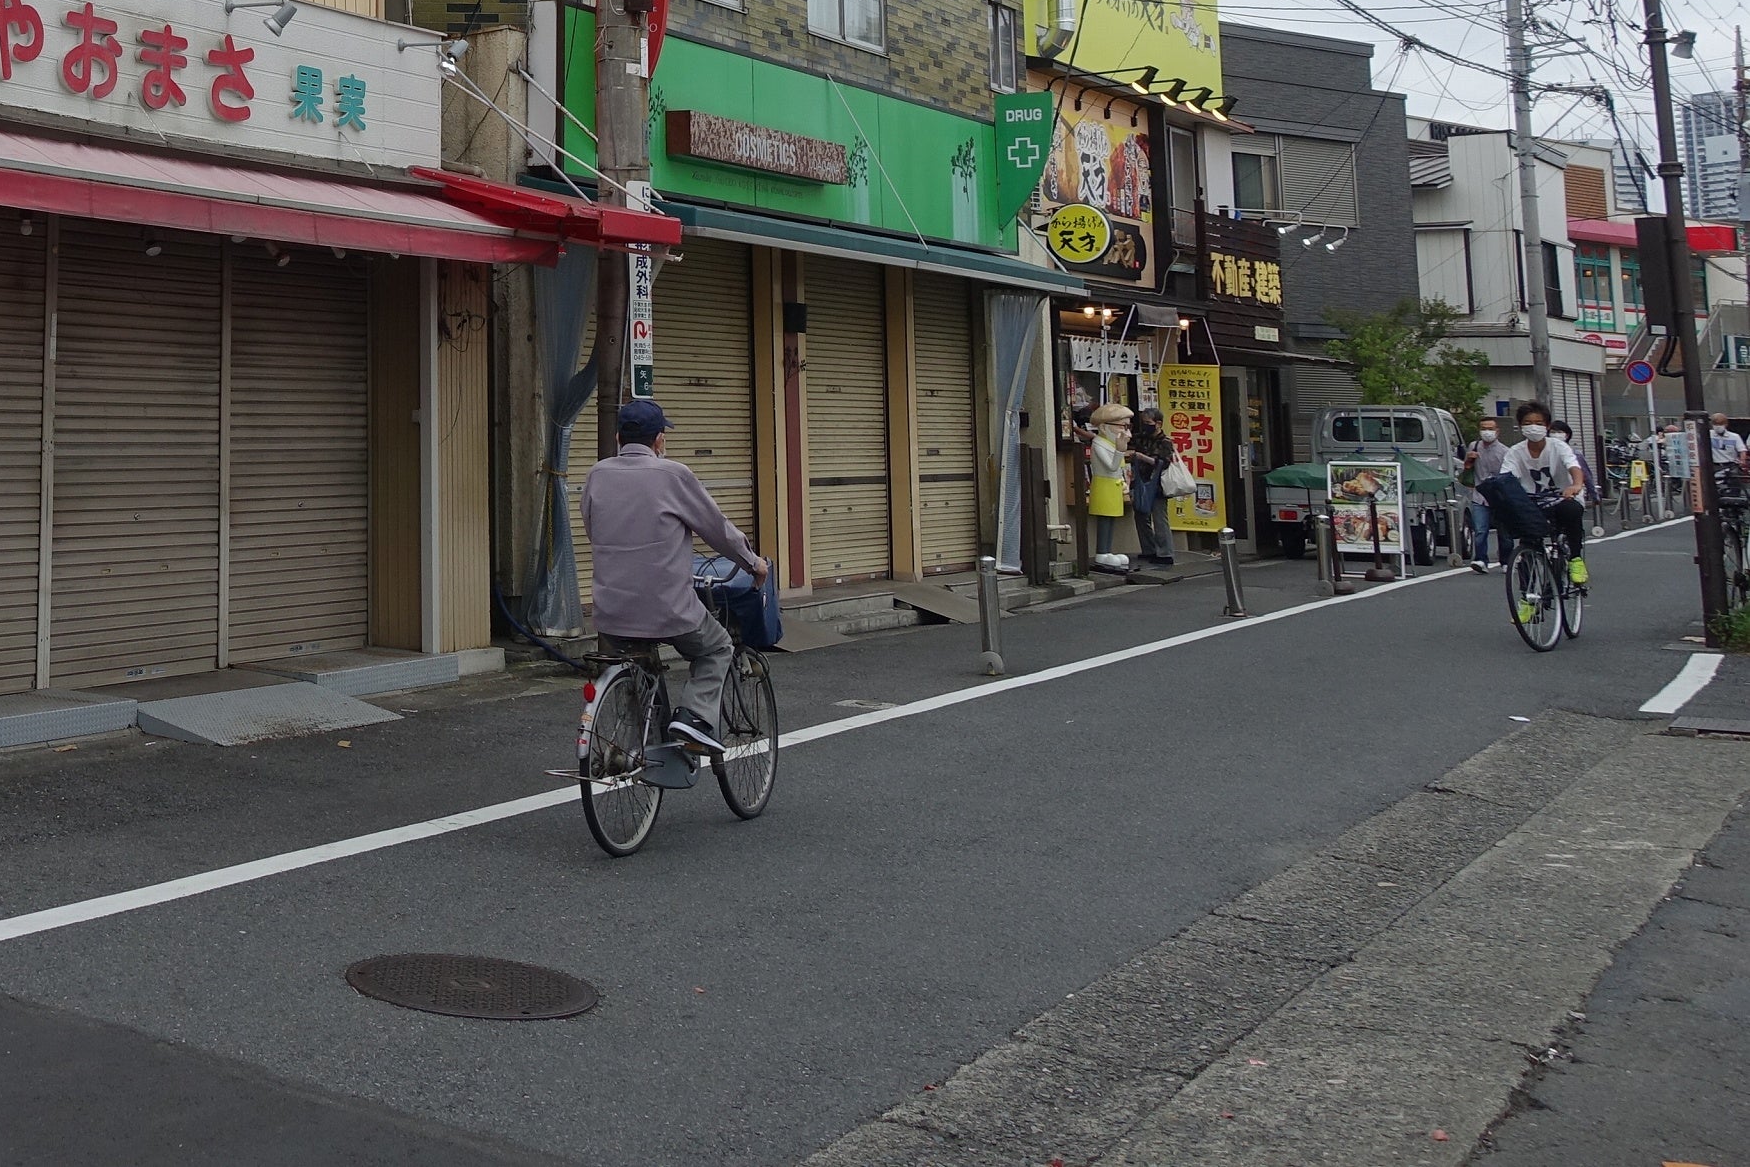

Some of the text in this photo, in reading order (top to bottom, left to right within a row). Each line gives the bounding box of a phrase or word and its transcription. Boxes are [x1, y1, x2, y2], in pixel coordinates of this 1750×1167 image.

[290, 63, 368, 132] 果実
[1005, 108, 1043, 123] DRUG
[735, 131, 797, 167] COSMETICS
[1050, 215, 1106, 230] から揚げの
[1057, 229, 1097, 254] 天才
[1190, 413, 1215, 477] ネット
